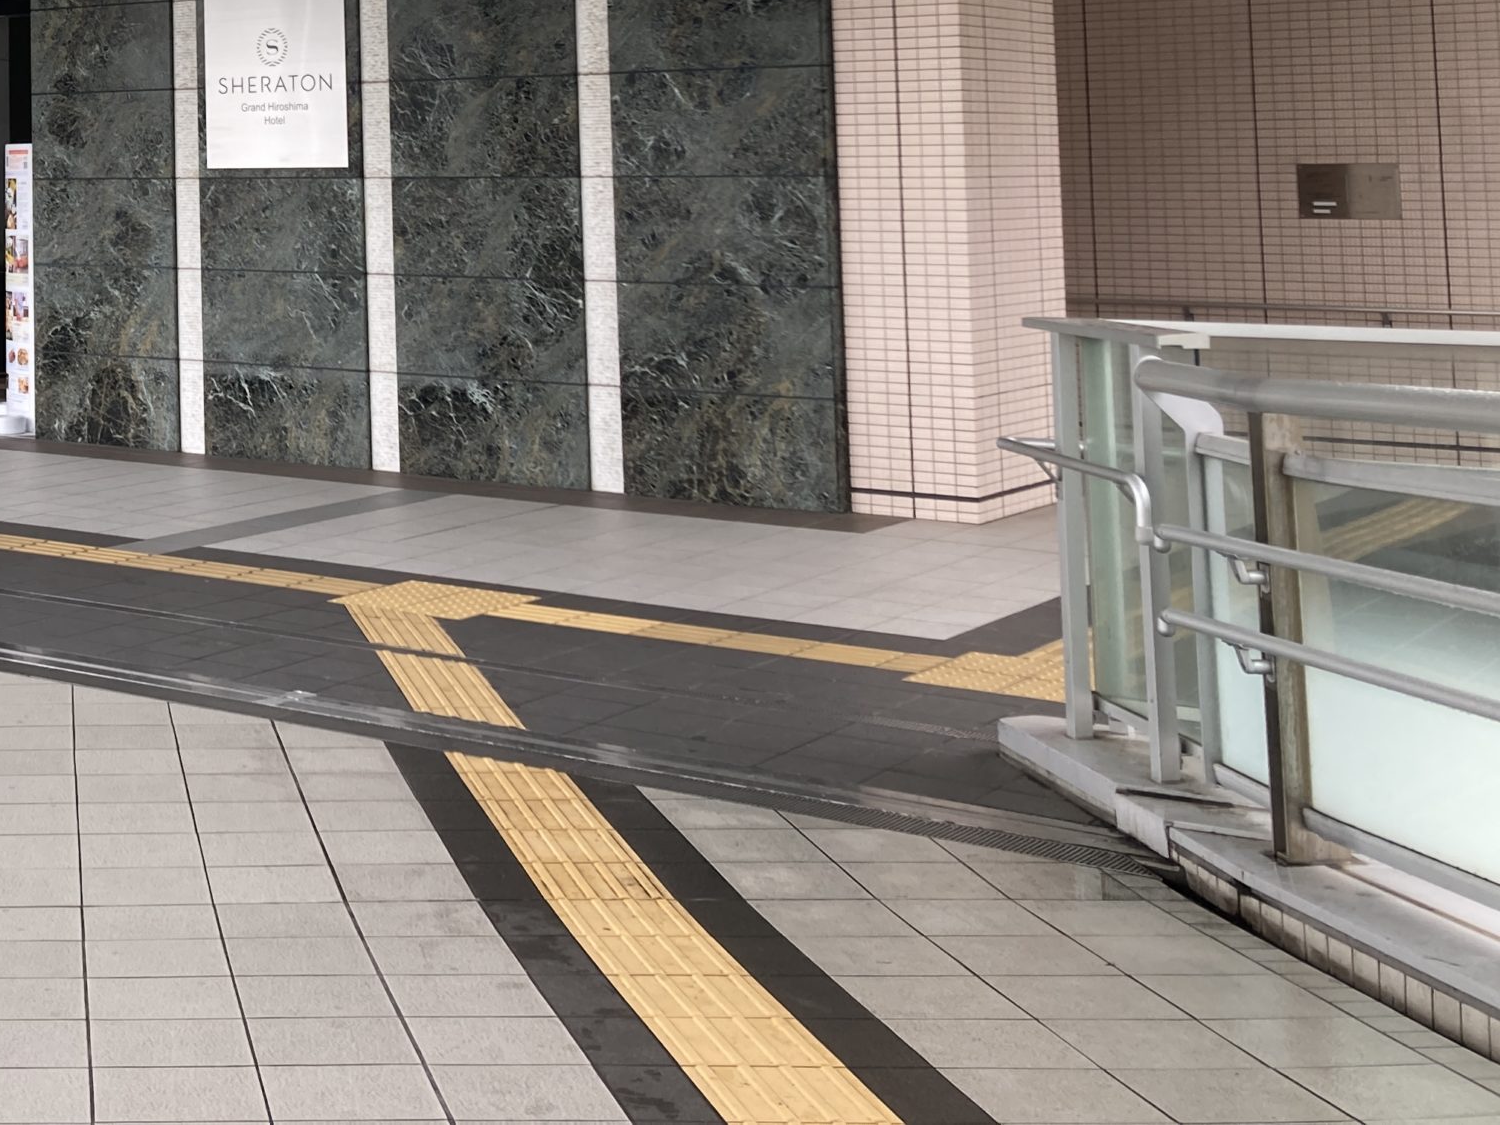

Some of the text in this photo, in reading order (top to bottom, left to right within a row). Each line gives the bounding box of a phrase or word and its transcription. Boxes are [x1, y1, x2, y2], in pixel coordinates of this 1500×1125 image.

[266, 39, 279, 56] S
[218, 73, 333, 95] SHERATON
[241, 101, 309, 113] Grand Hiroshima
[264, 115, 286, 126] Hotel
